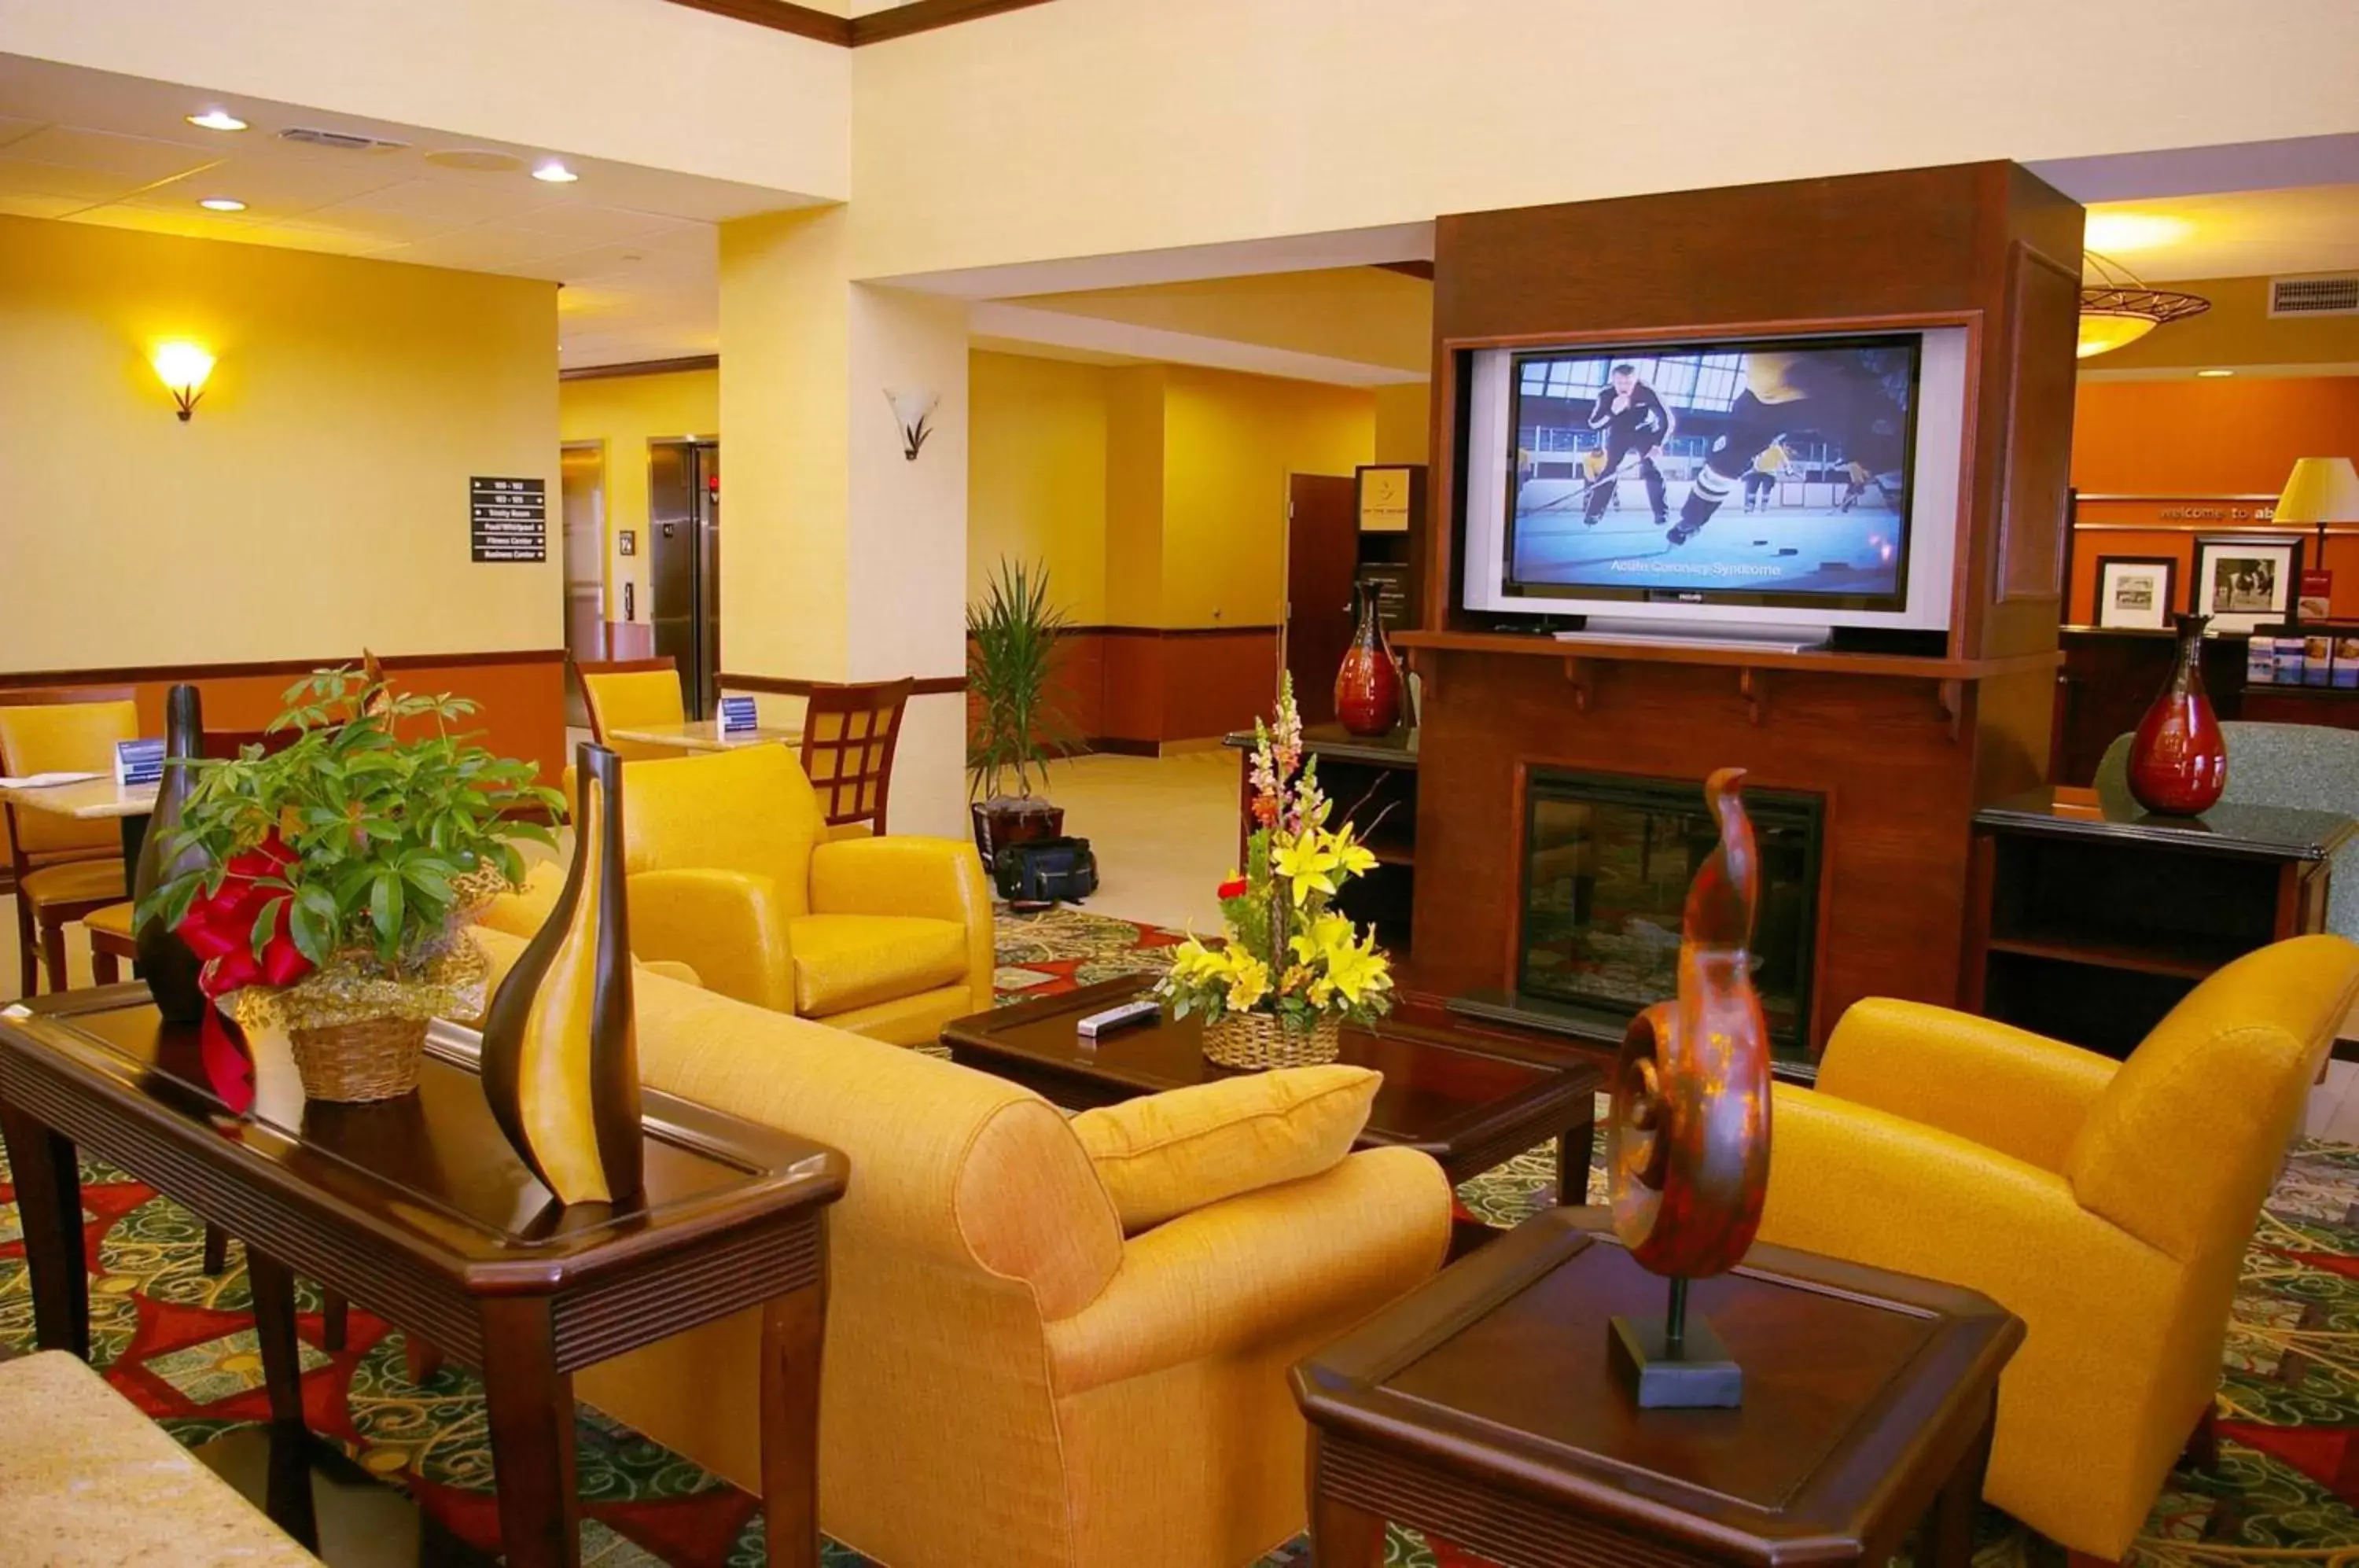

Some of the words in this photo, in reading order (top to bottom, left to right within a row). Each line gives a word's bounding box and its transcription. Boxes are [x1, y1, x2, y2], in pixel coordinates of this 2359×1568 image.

[2161, 506, 2222, 519] welcome
[2232, 506, 2247, 519] to
[2255, 506, 2275, 520] ab
[1611, 559, 1649, 572] Acute
[1653, 562, 1709, 576] Coronary
[1712, 562, 1782, 576] Syndrome
